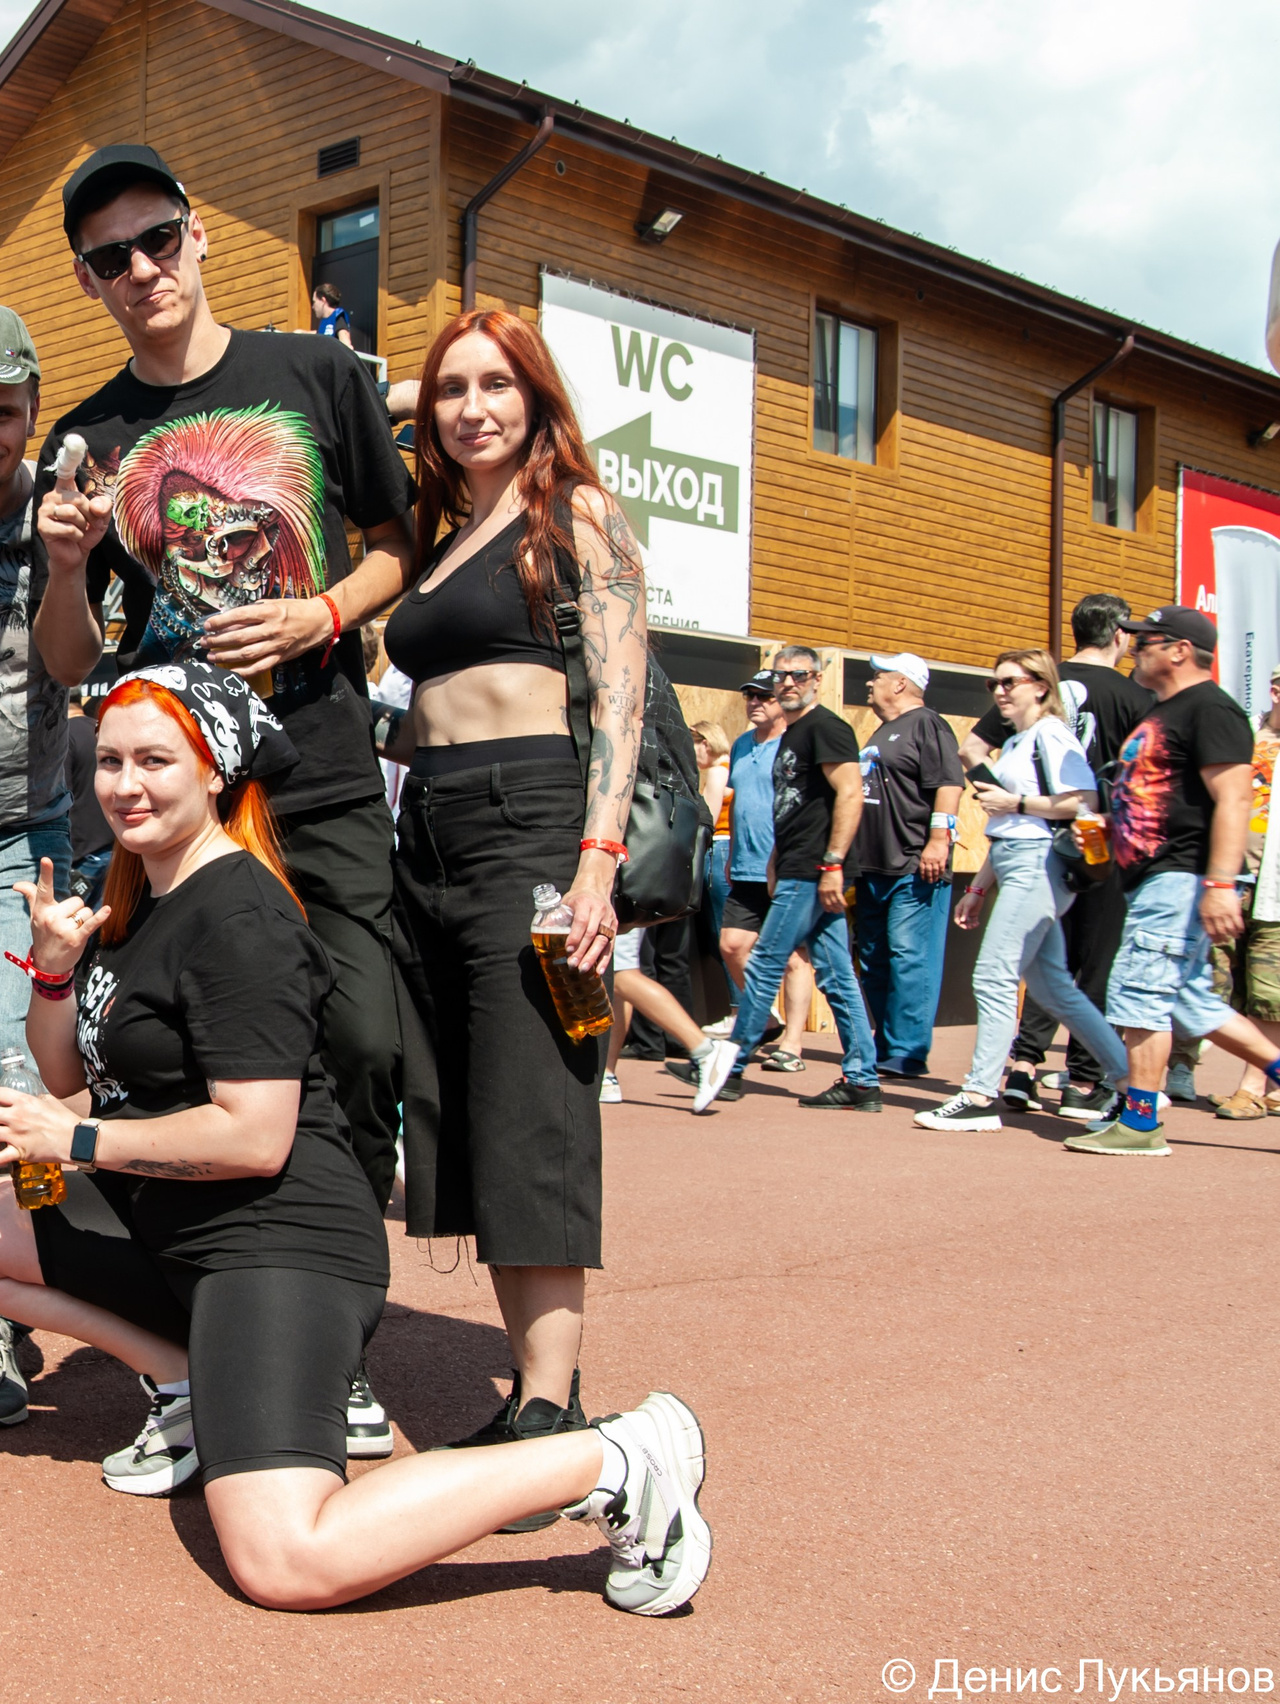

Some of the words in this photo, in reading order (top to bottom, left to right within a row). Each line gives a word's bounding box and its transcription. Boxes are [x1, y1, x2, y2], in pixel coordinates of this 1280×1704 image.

[611, 325, 694, 402] WC
[598, 448, 725, 526] ВЫХОД
[646, 587, 673, 606] СТА
[81, 966, 117, 1021] SEX
[638, 1444, 662, 1477] CROSBY
